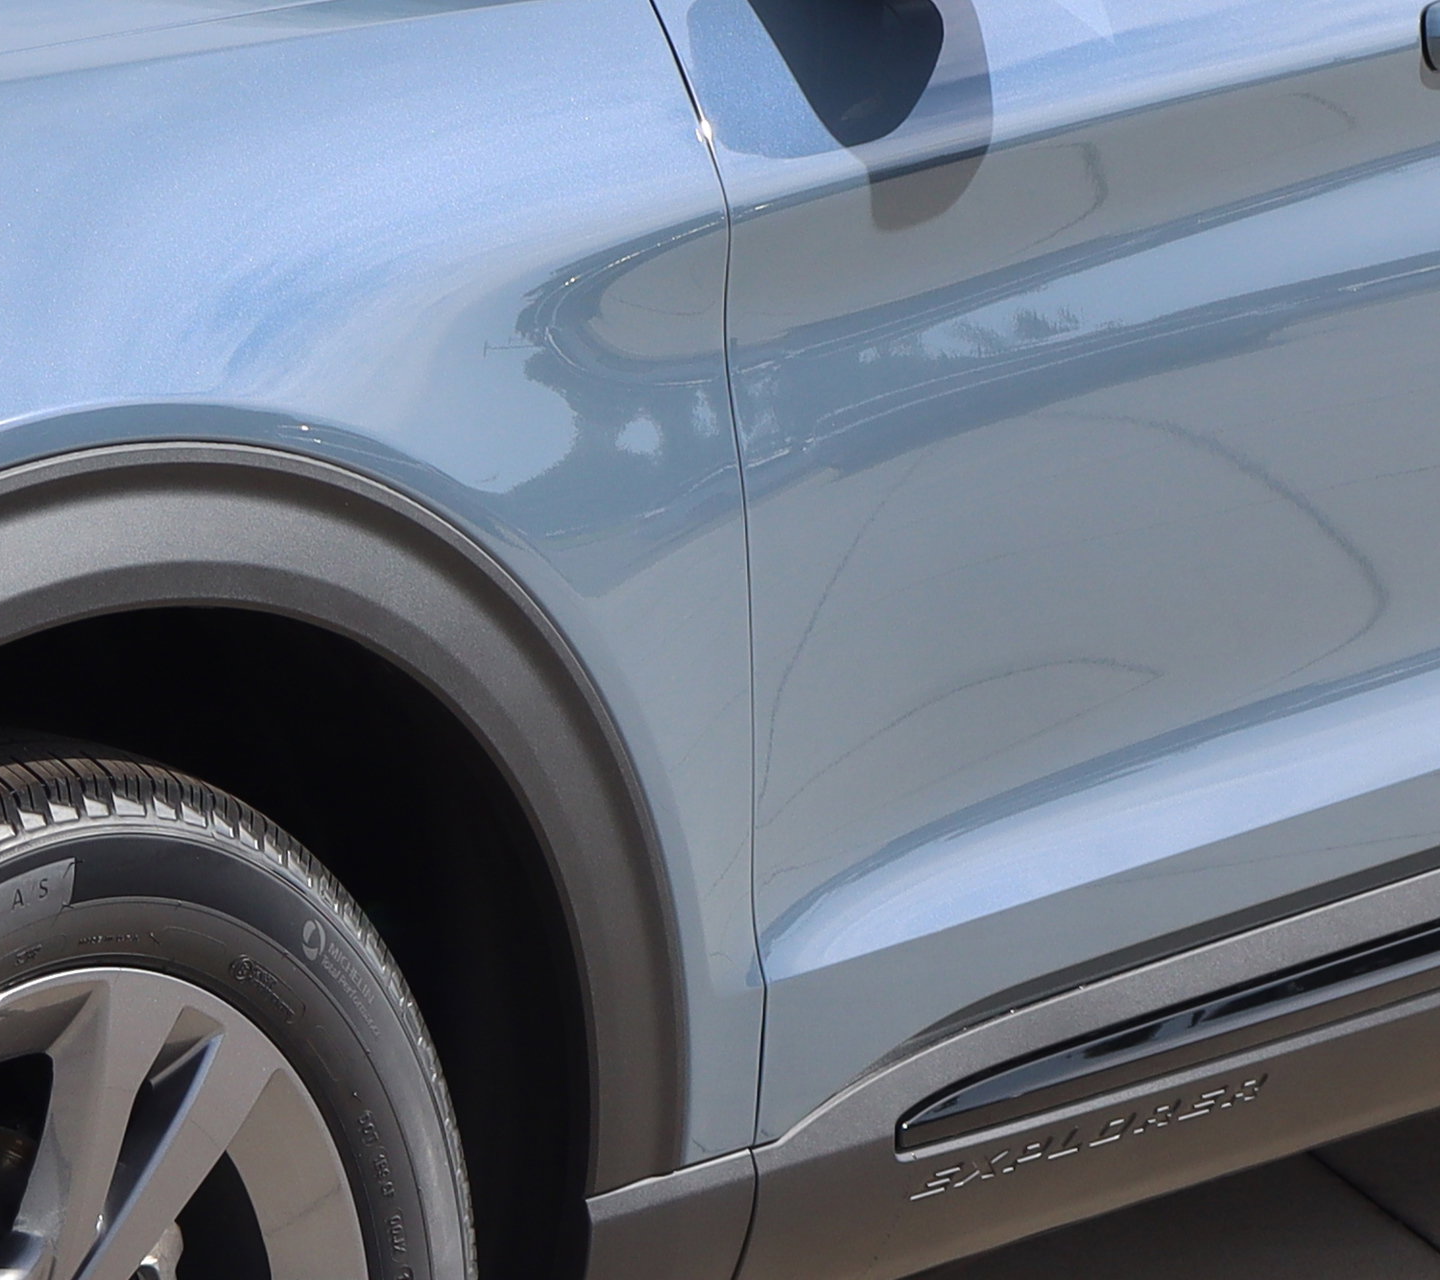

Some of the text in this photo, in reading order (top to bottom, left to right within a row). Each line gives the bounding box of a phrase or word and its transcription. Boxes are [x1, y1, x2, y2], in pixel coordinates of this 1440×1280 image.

[319, 953, 342, 980] Total
[326, 940, 376, 1007] MICHELIN
[909, 1073, 1269, 1201] EXPLORER
